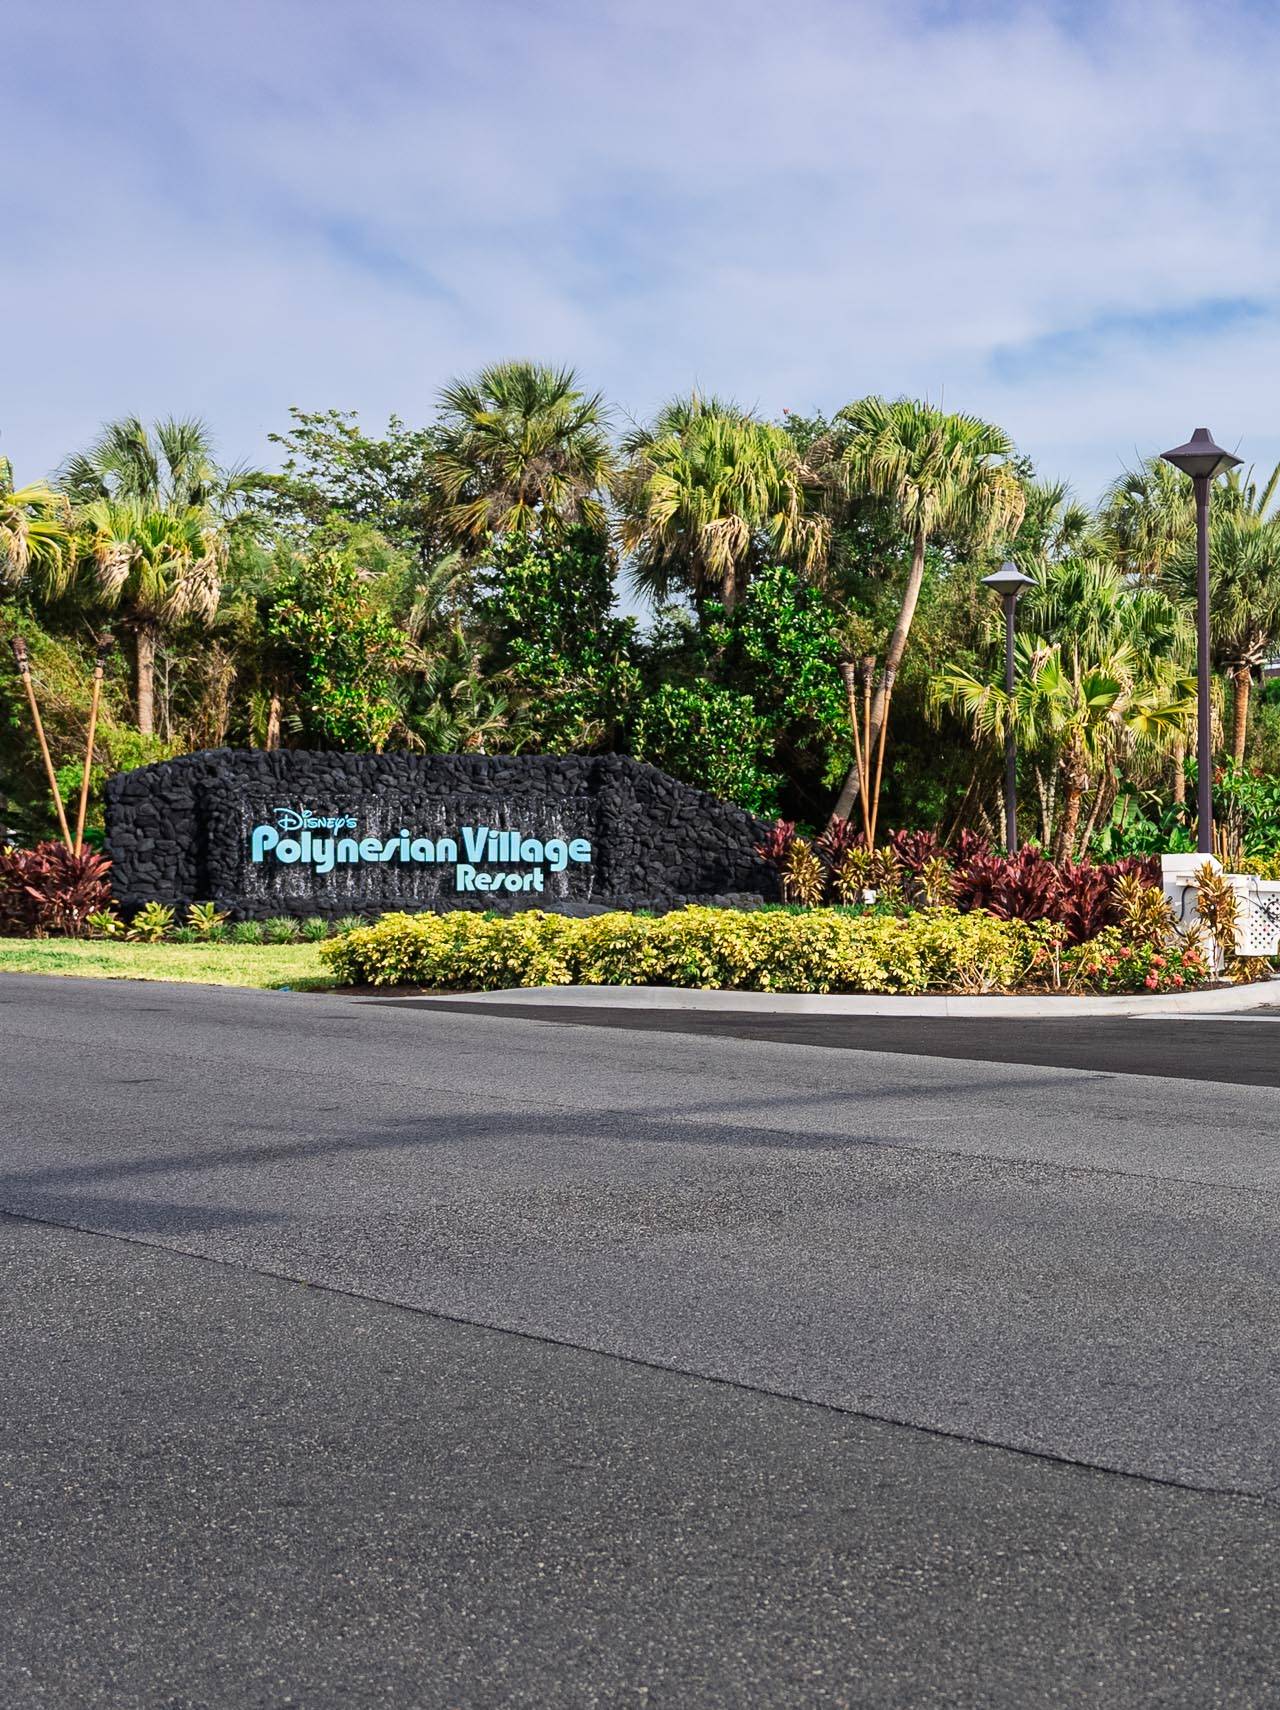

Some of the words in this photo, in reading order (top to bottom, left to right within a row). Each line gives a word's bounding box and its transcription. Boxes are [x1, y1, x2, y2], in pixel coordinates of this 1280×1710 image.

[273, 807, 358, 834] Disney's
[251, 825, 458, 874] Polynesian
[461, 826, 592, 872] Village
[456, 864, 544, 892] Resort
